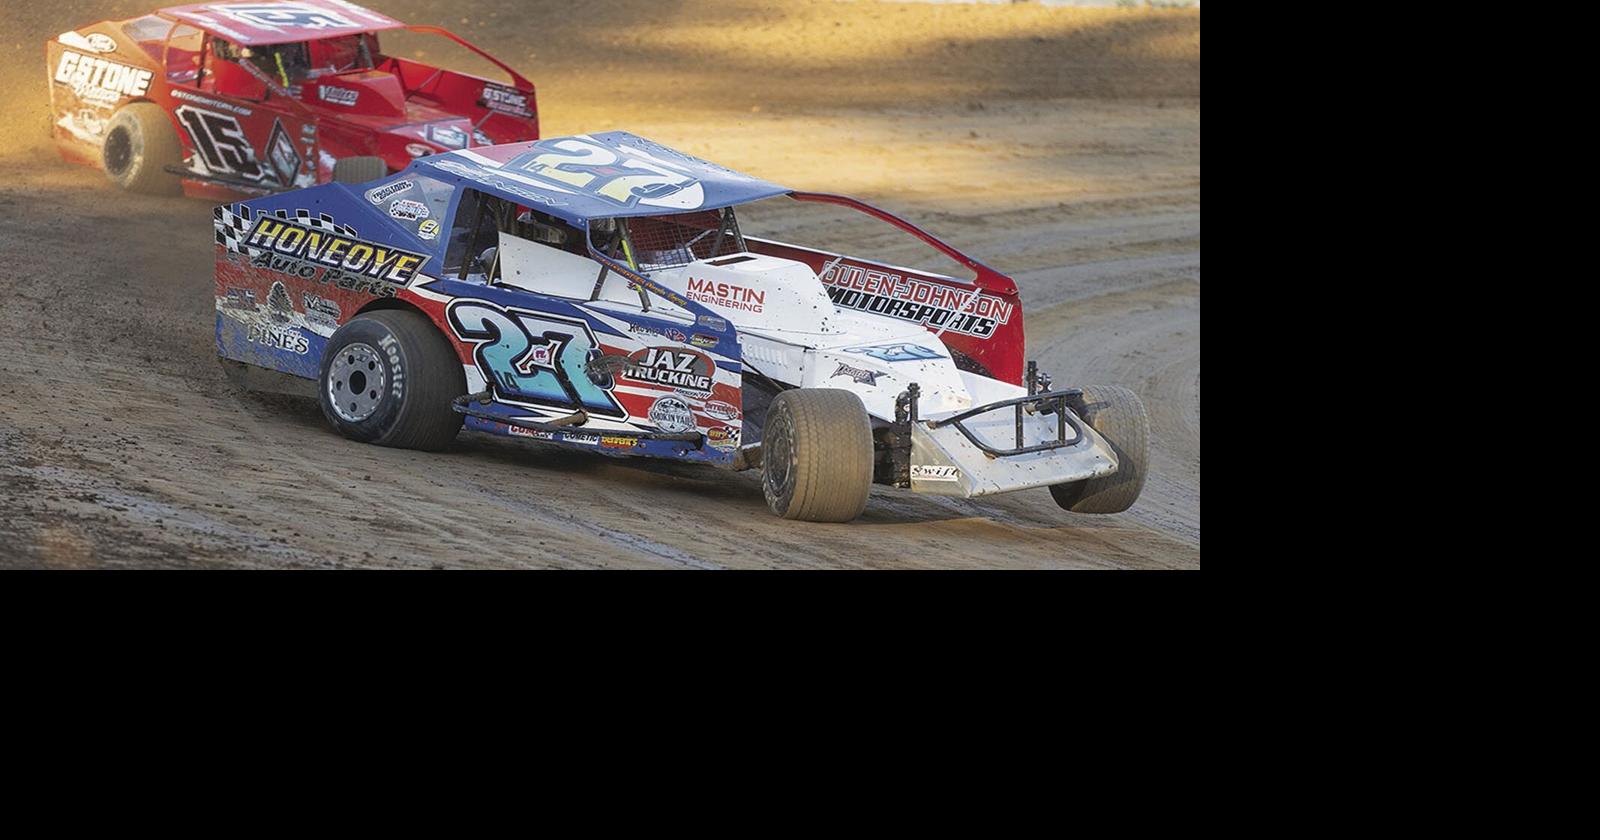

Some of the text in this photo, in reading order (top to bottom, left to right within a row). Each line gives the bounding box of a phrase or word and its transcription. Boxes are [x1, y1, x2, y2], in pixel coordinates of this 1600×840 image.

[175, 105, 265, 181] 15
[250, 220, 420, 283] HONEOYE
[252, 250, 397, 298] Auto Parts
[687, 276, 765, 305] MASTIN
[686, 291, 763, 313] ENGINEERING
[445, 296, 629, 423] 27
[625, 364, 711, 389] TRUCKING
[639, 348, 697, 373] JAZ
